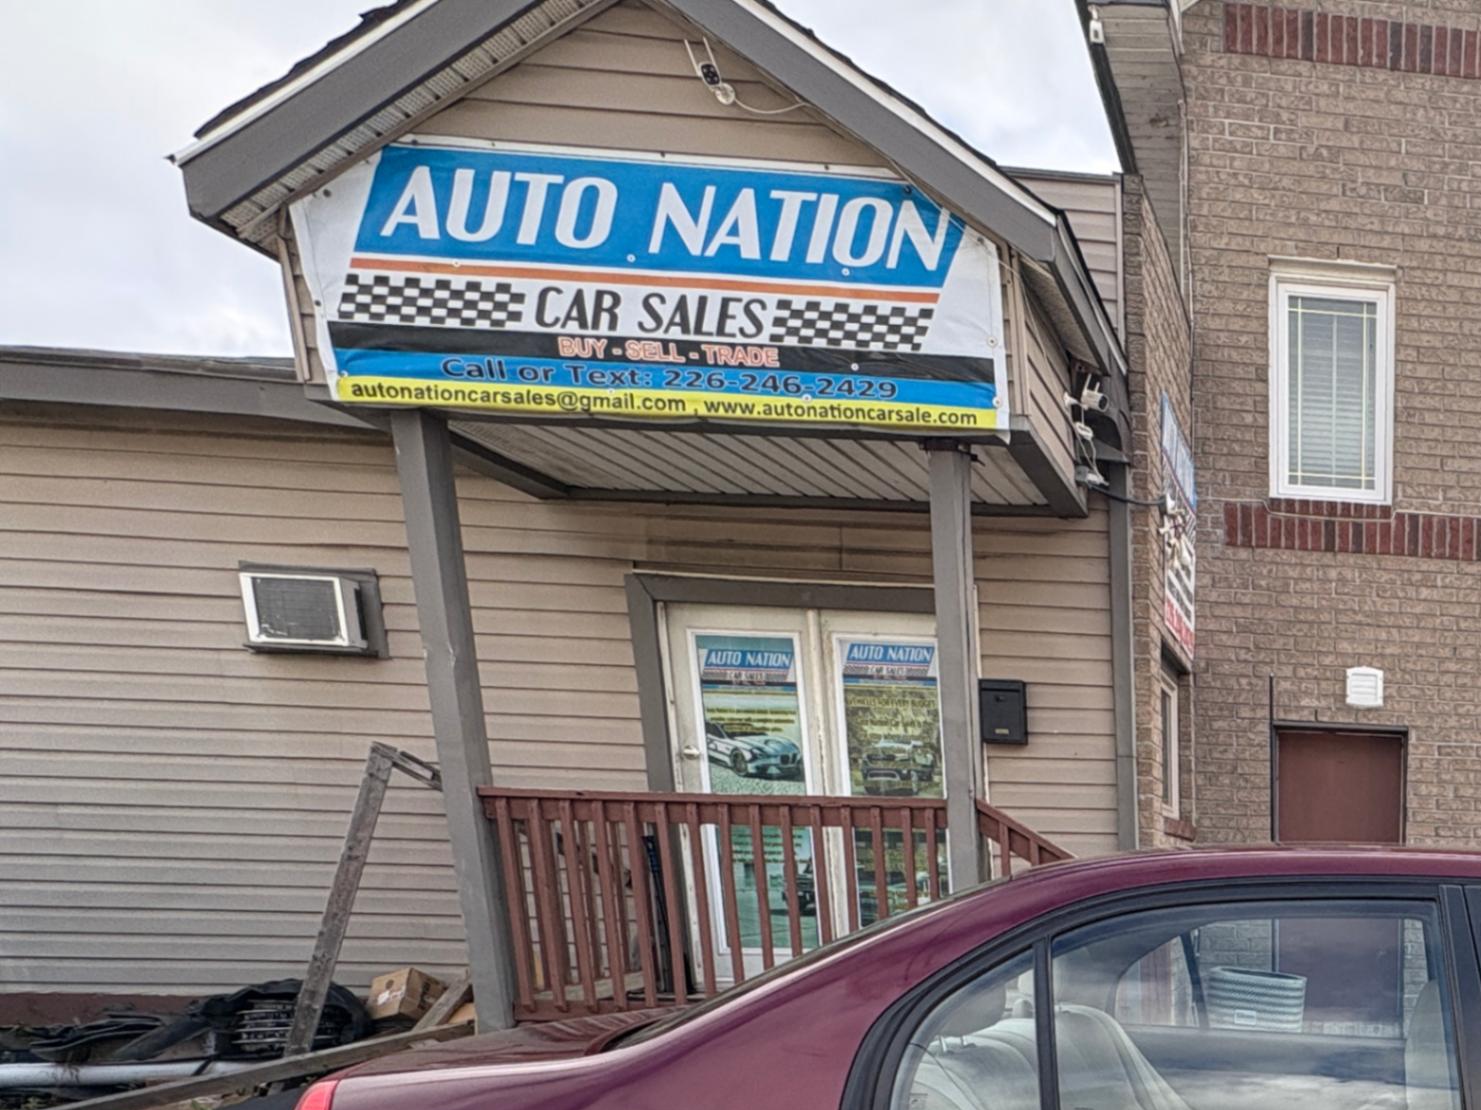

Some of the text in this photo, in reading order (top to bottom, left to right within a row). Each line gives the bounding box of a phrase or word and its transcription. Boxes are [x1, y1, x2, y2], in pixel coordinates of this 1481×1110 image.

[380, 166, 950, 271] AUTO NATION
[535, 286, 767, 339] CAR SALES
[557, 336, 608, 359] BUY
[625, 339, 685, 363] SELL
[702, 344, 780, 368] TRADE
[442, 357, 898, 400] Call or Text: 226-246-2429
[351, 382, 686, 413] autonationcarsales@gmail.com
[704, 399, 978, 425] www.autonationcarsale.com
[706, 650, 792, 667] AUTO NATION
[849, 645, 933, 662] AUTO NATION
